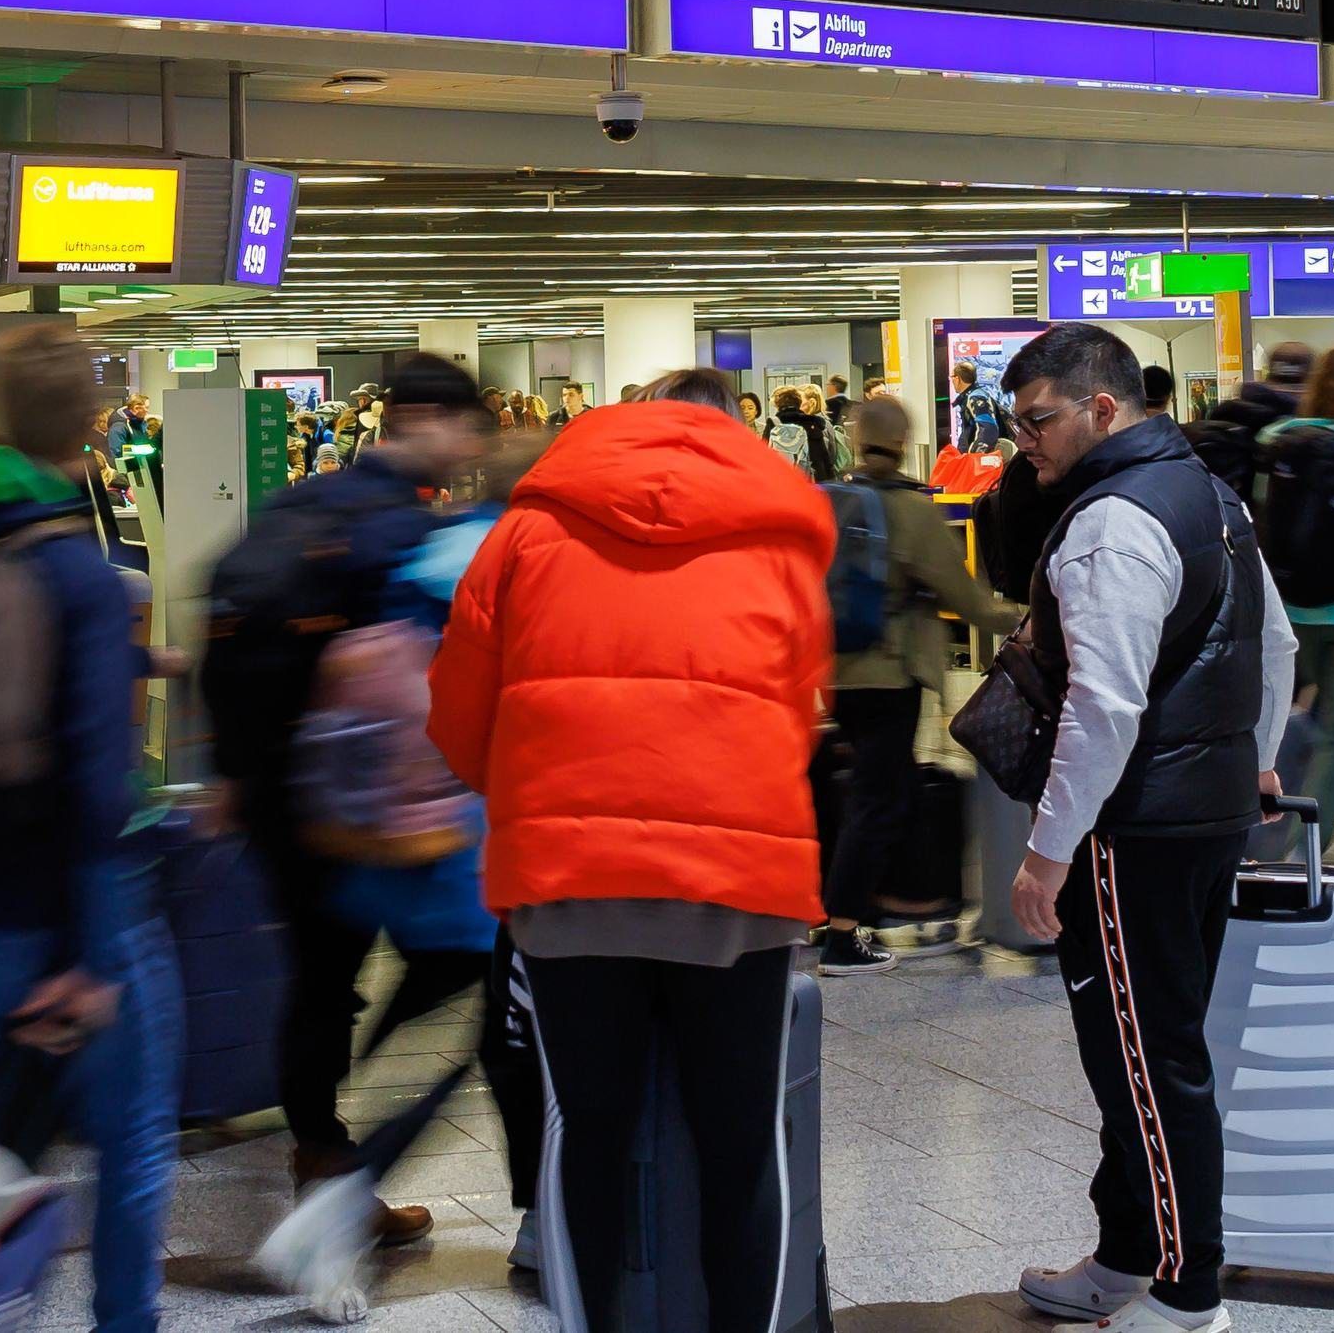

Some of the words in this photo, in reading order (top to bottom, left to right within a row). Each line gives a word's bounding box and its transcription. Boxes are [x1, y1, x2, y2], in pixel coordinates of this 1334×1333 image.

[824, 14, 866, 39] Abflug
[824, 37, 893, 60] Departures
[67, 181, 154, 202] Lufthansa
[65, 241, 145, 253] lufthansa.com
[56, 263, 81, 272] STAR
[83, 263, 126, 272] ALLIANCE
[243, 244, 266, 274] 499
